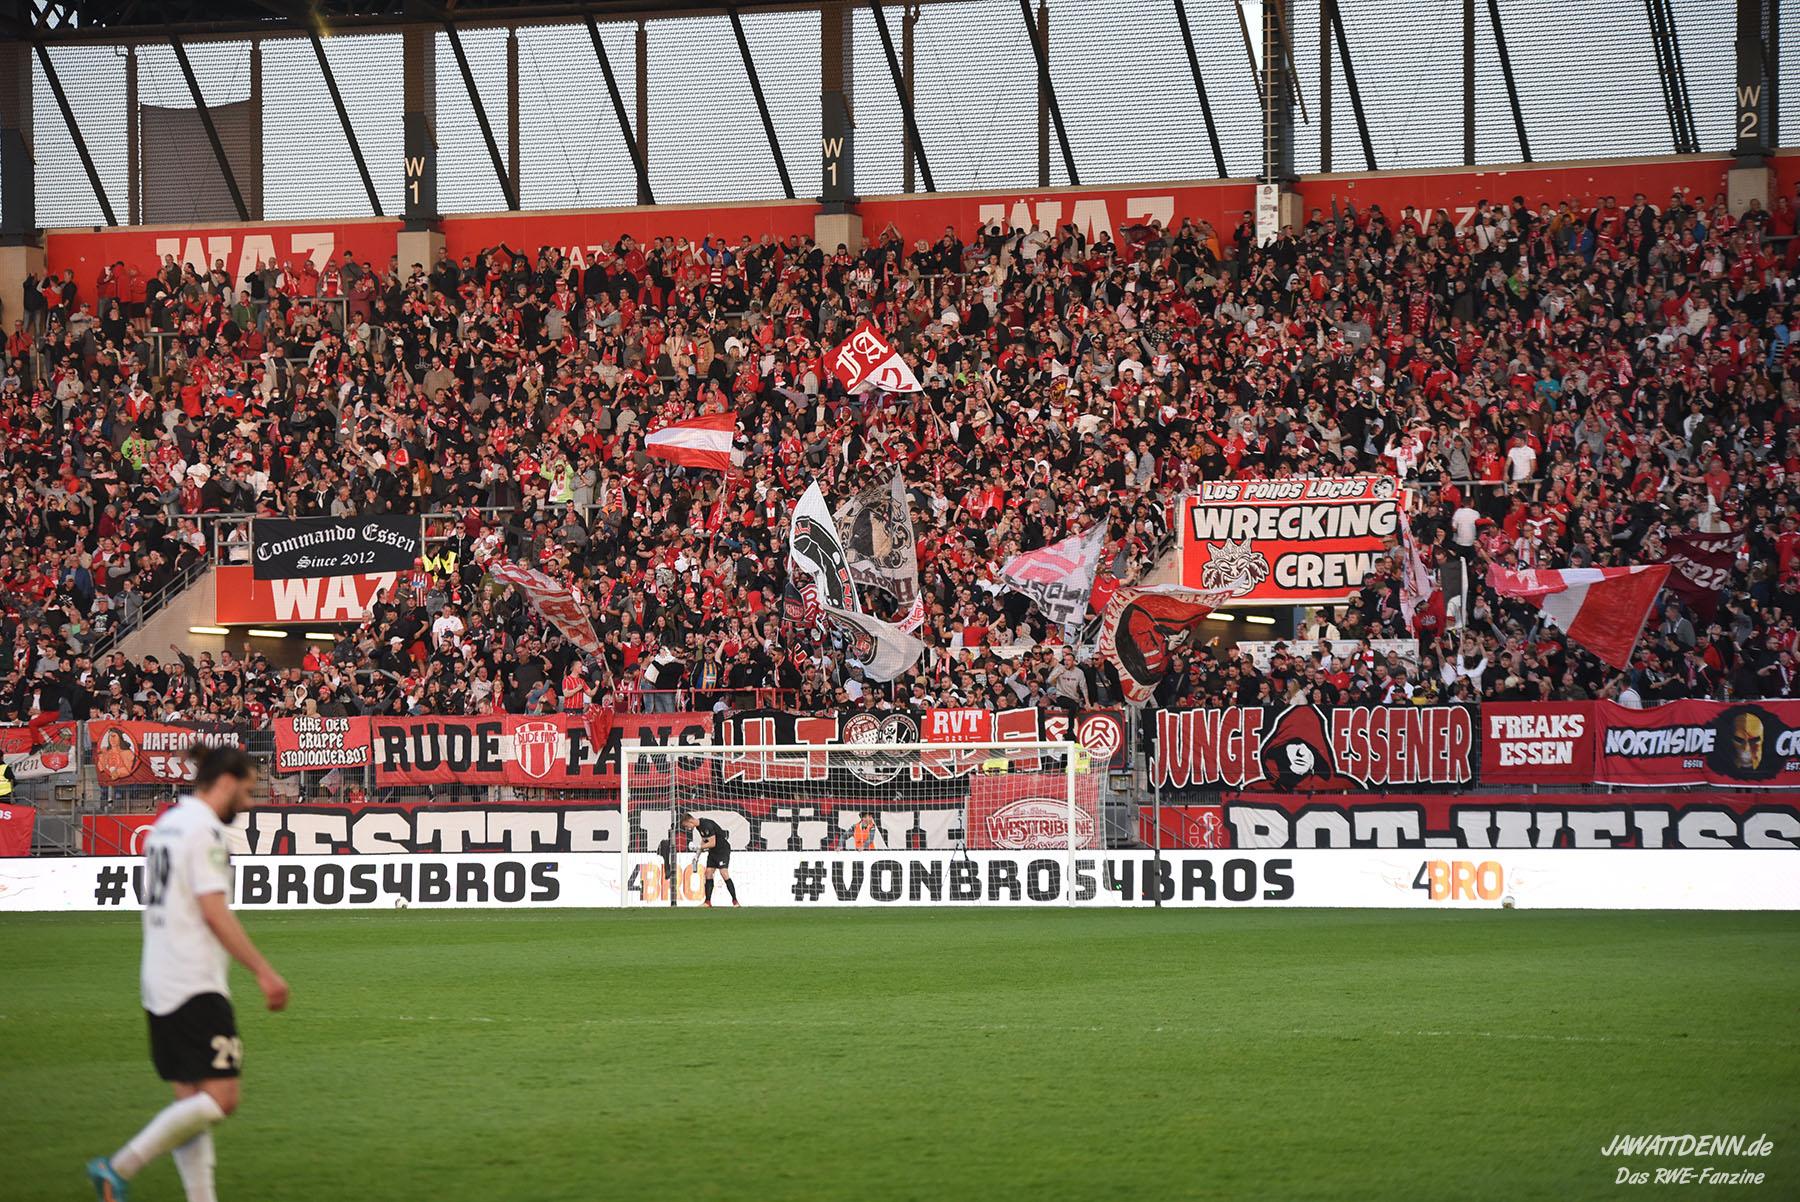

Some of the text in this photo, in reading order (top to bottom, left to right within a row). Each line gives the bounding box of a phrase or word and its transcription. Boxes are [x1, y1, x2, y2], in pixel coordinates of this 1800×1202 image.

[1737, 85, 1761, 107] W
[1740, 112, 1758, 138] 2
[823, 137, 844, 158] W
[404, 156, 425, 177] W
[827, 162, 837, 186] 1
[409, 180, 419, 204] 1
[979, 196, 1175, 260] WAZ
[156, 232, 335, 300] WAZ
[1202, 484, 1242, 500] LOS
[1306, 480, 1368, 499] LOCOS
[1192, 503, 1397, 541] WRECKING
[256, 523, 416, 562] Commando Essen
[296, 551, 376, 569] Since 2012
[1274, 553, 1386, 588] CREW
[271, 571, 397, 621] WAZ
[293, 716, 322, 733] EHRE
[932, 711, 984, 735] RVT
[1490, 714, 1585, 739] FREAKS
[299, 733, 344, 749] GRUPPE
[379, 721, 504, 773] RUDE
[1149, 706, 1266, 790] JUNGE
[1331, 705, 1473, 785] ESSENER
[1499, 741, 1574, 766] ESSEN
[1605, 727, 1717, 756] NORTHSIDE
[150, 756, 198, 781] ESS
[791, 858, 1295, 902] #VONBROS4BROS
[1412, 860, 1504, 901] 4BRO
